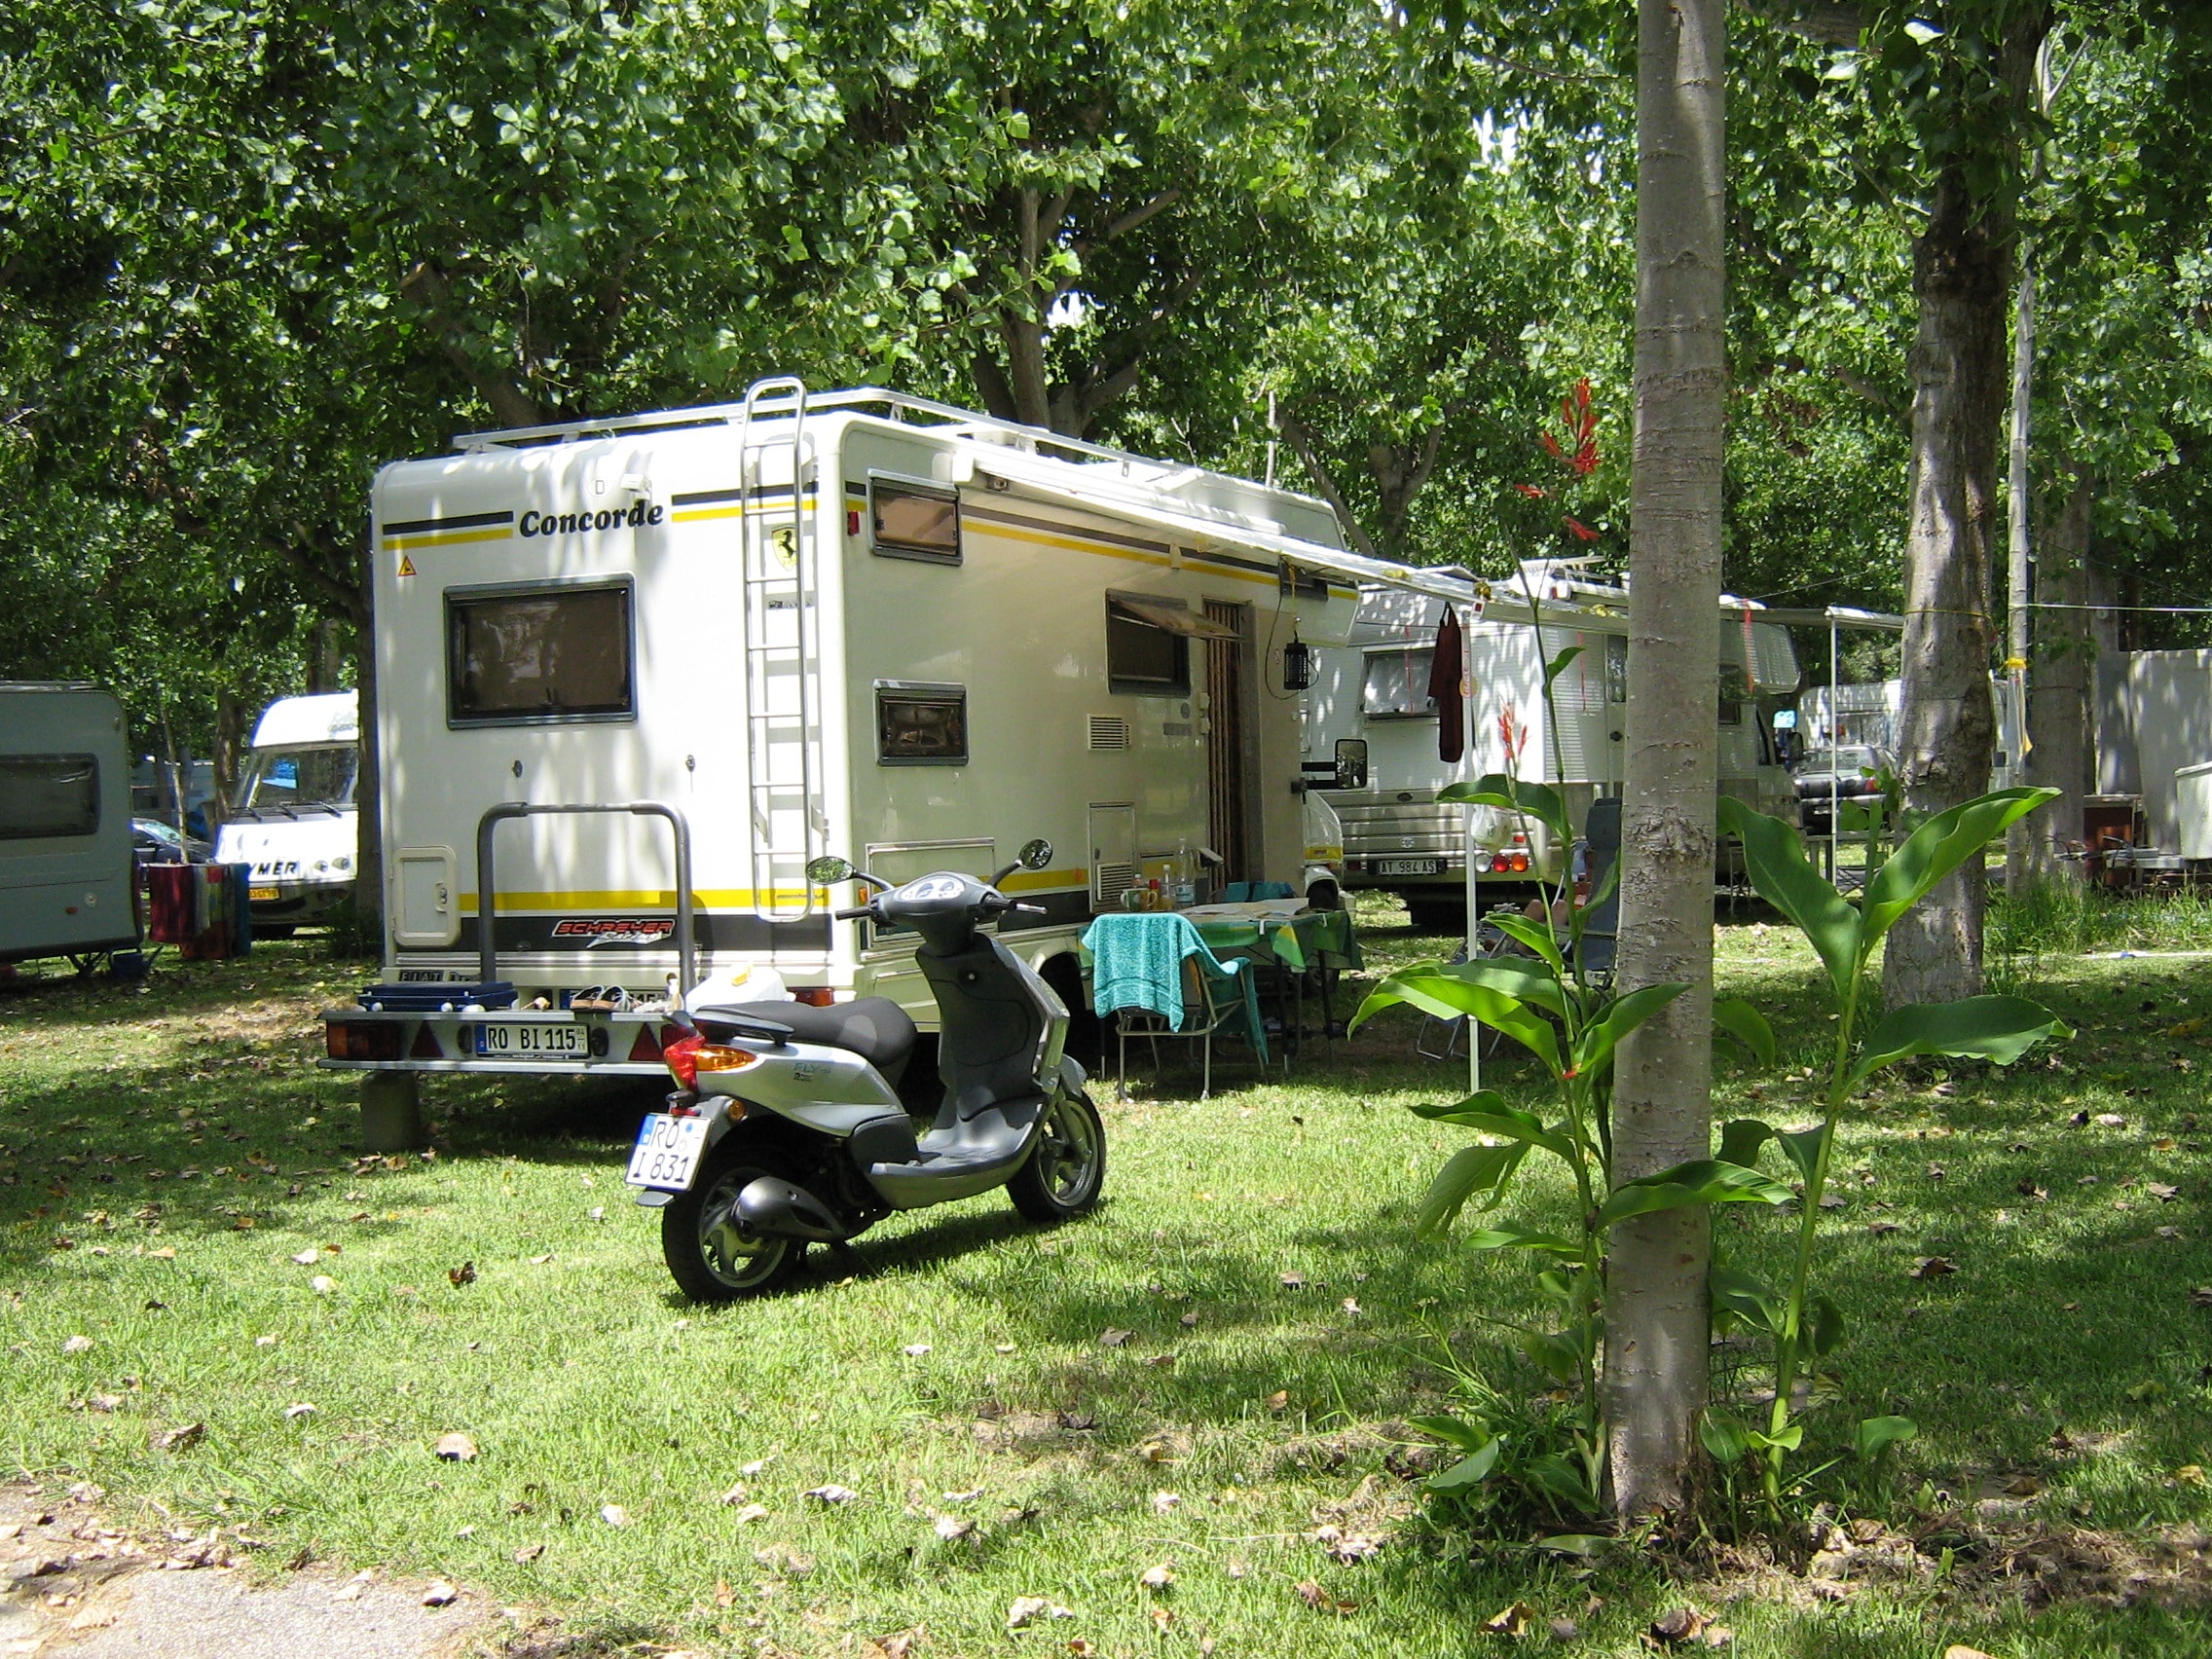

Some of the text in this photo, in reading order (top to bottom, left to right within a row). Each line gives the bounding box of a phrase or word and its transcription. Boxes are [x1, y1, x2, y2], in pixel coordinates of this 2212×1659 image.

[519, 499, 663, 537] Concorde
[557, 922, 673, 934] SCHREYER
[400, 971, 441, 981] FIAT
[488, 1028, 575, 1051] RO BI 115
[650, 1121, 680, 1149] RO
[649, 1153, 689, 1183] 831
